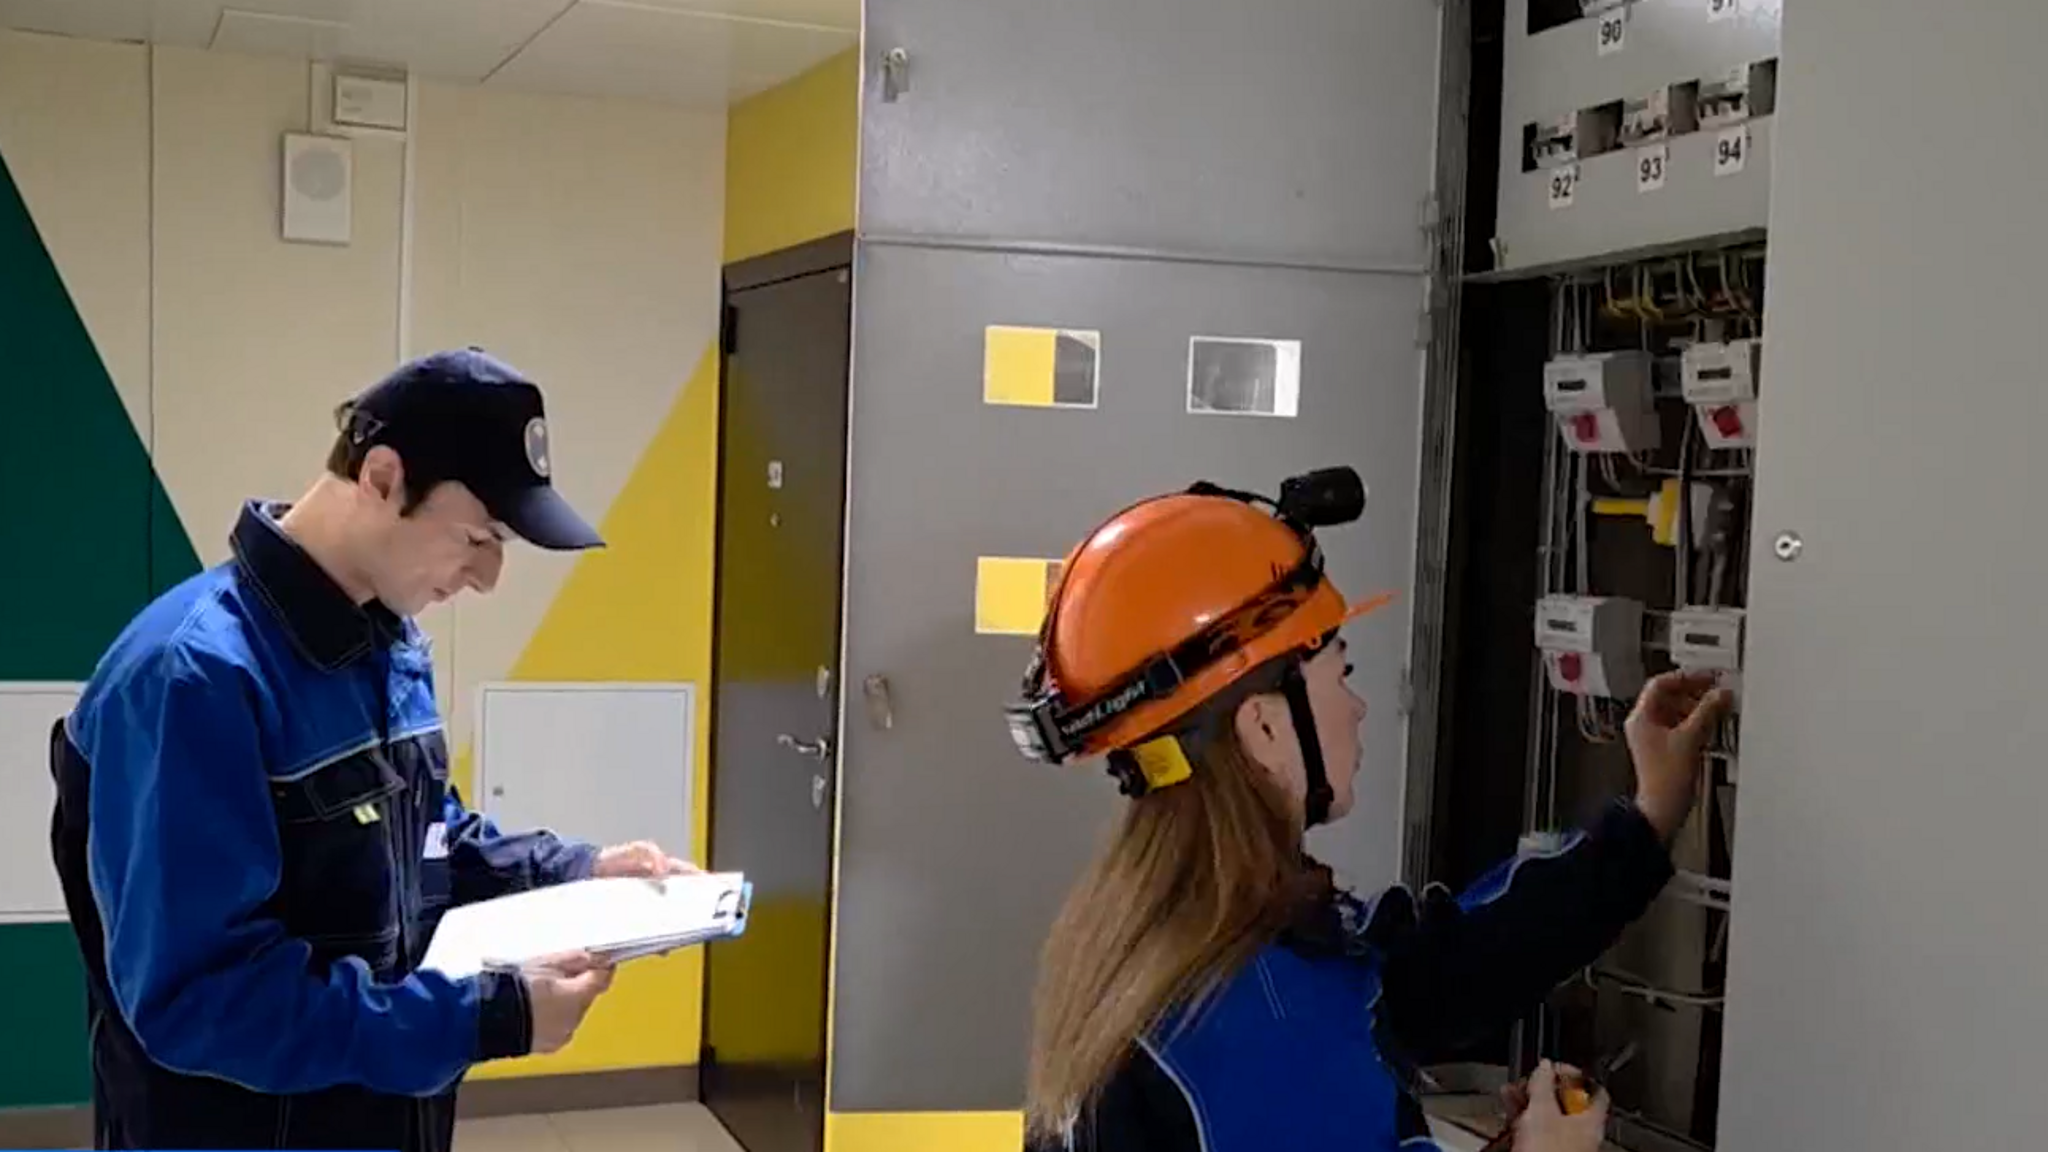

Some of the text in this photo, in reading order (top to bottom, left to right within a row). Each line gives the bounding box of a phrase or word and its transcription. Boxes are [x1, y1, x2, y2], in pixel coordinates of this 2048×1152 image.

[1601, 19, 1622, 45] 90
[1719, 136, 1741, 165] 94
[1641, 157, 1662, 183] 93
[1552, 174, 1572, 199] 92
